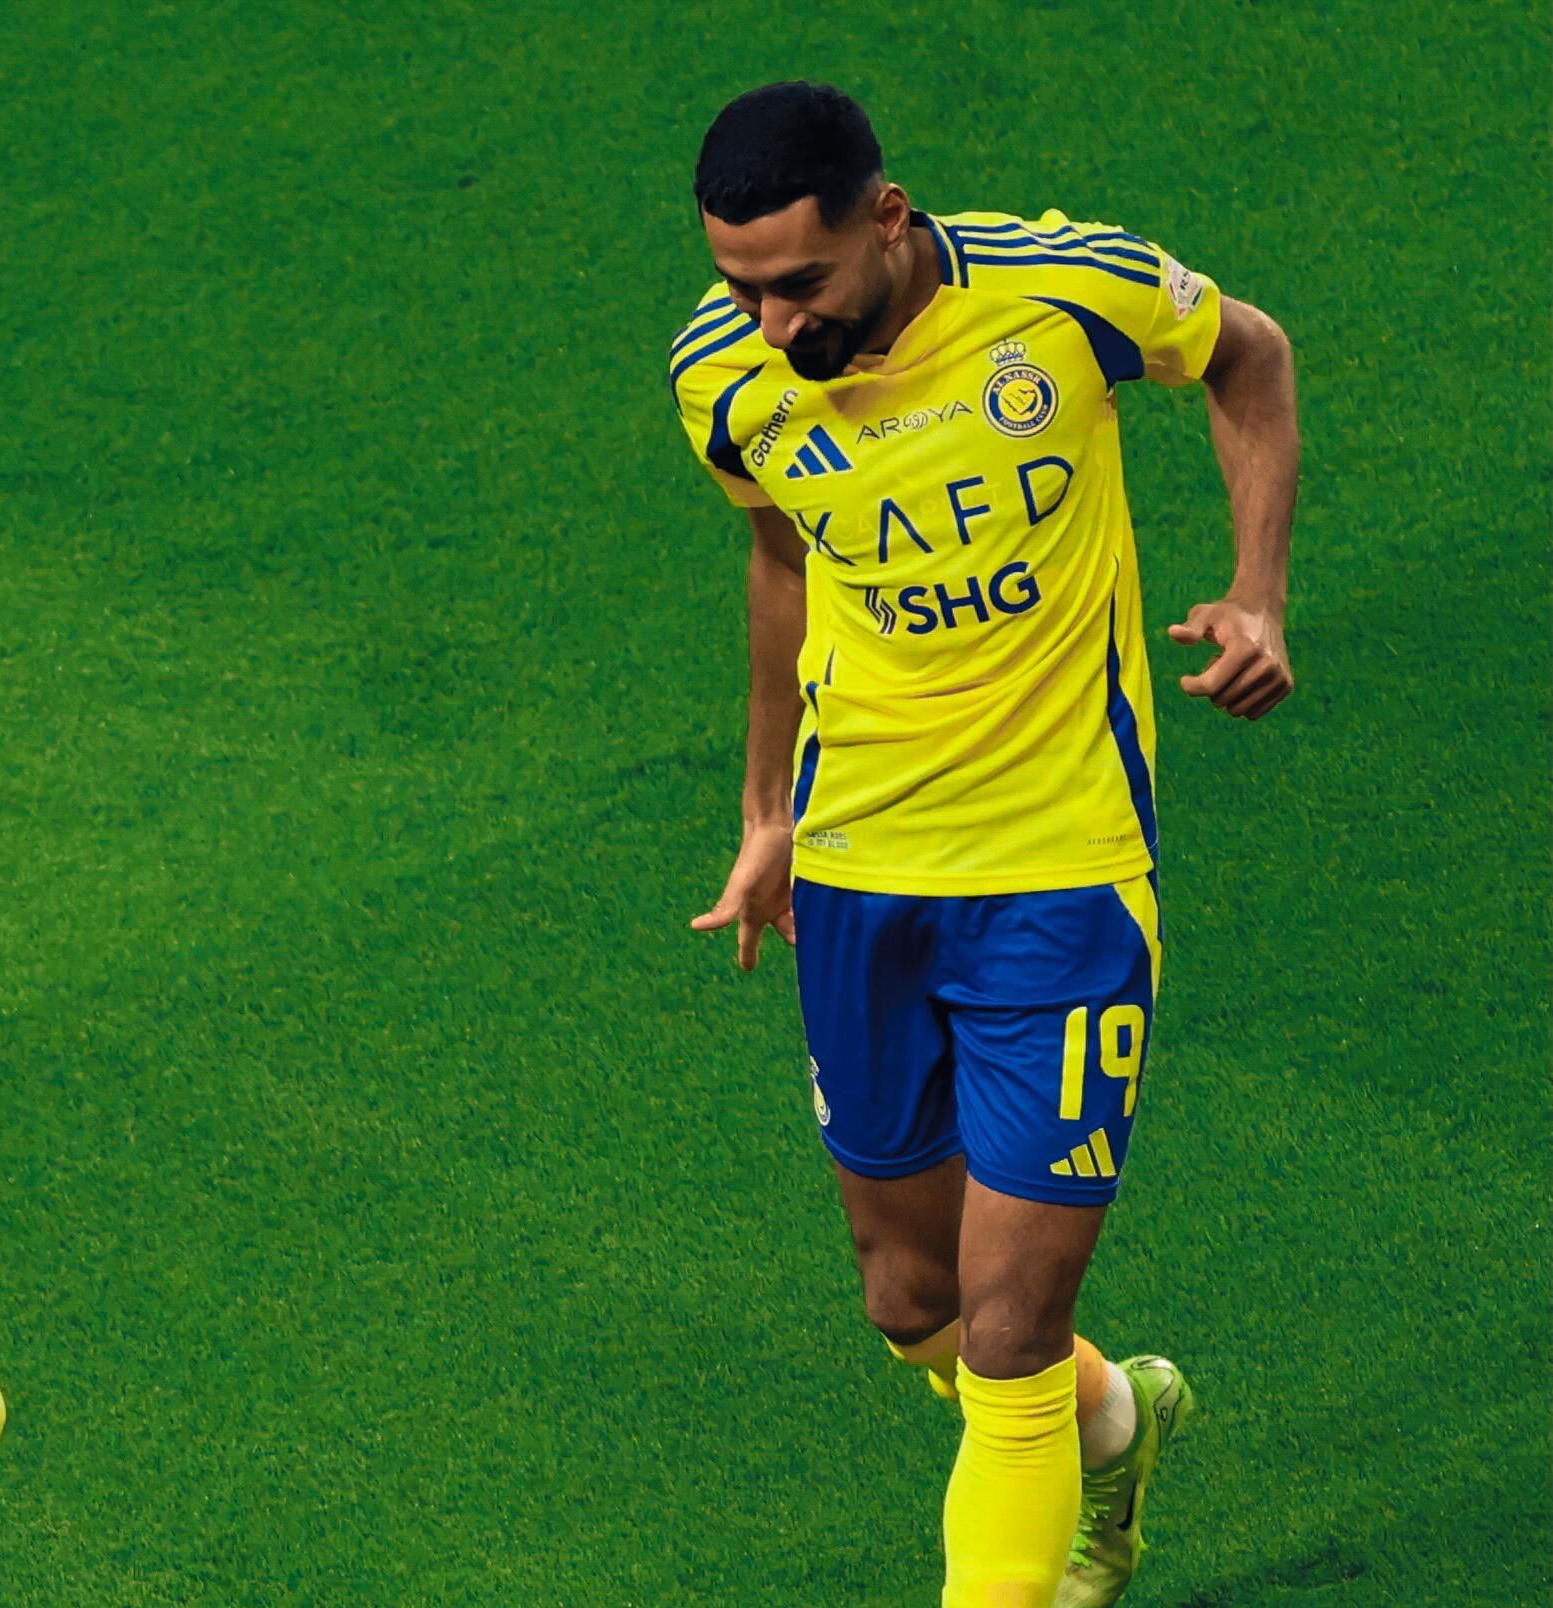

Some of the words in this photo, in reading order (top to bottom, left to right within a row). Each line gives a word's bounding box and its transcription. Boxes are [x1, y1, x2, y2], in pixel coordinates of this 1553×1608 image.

[750, 389, 799, 468] Gathern
[796, 455, 1075, 567] KAFD
[897, 561, 1042, 635] SHG
[1059, 1003, 1147, 1121] 19
